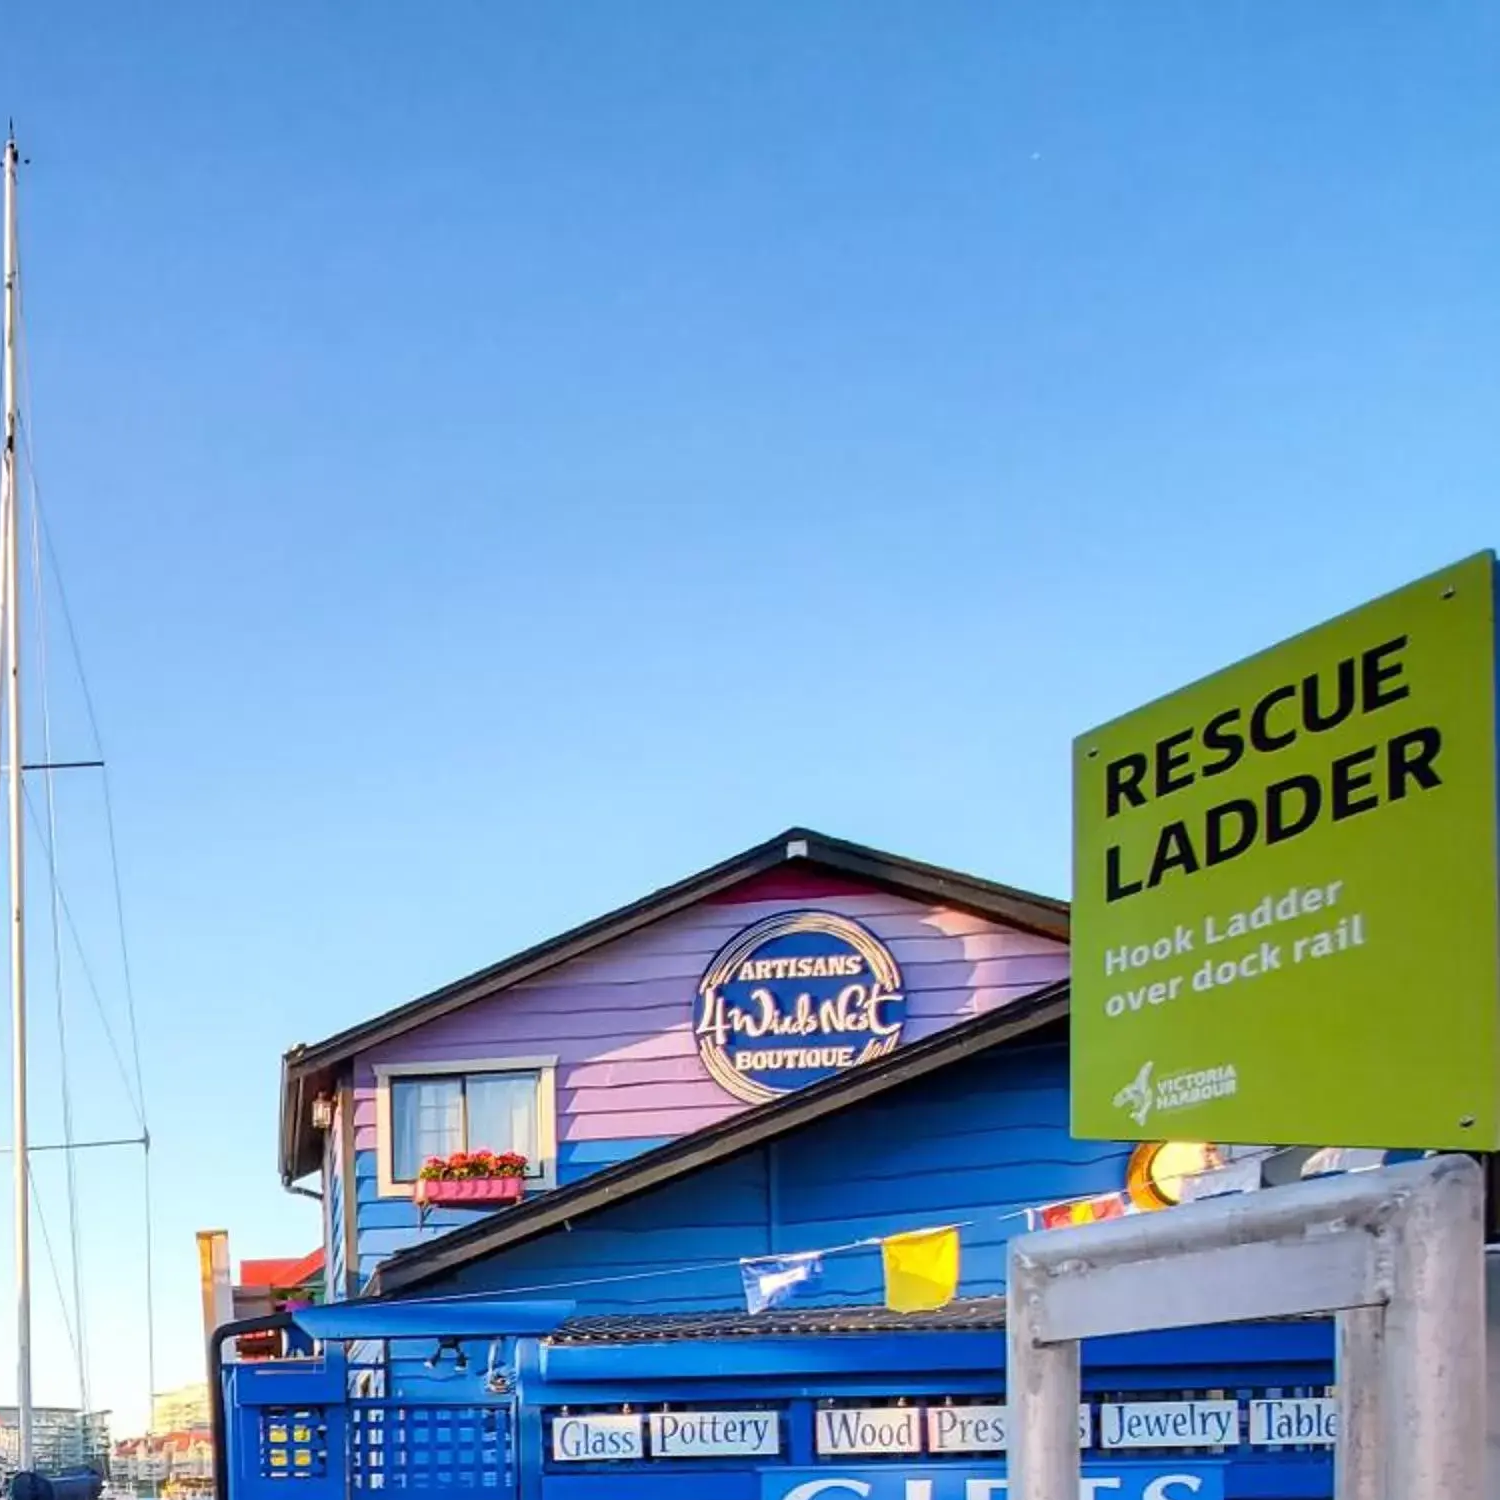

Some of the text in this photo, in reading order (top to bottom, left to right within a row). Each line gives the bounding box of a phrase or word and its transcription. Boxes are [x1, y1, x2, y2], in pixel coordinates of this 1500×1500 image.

[1106, 634, 1410, 818] RESCUE
[1106, 726, 1443, 903] LADDER
[1104, 879, 1343, 976] Hook Ladder
[738, 954, 862, 981] ARTISANS
[1104, 913, 1366, 1017] over dock rail
[819, 984, 904, 1036] Nest
[735, 1046, 856, 1071] BOUTIQUE
[1156, 1064, 1237, 1096] VICTORIA
[1156, 1078, 1237, 1110] HARBOUR
[559, 1420, 636, 1457] Glass
[658, 1414, 770, 1452] Pottery
[824, 1410, 913, 1450] Wood
[1107, 1403, 1232, 1444] Jewelry
